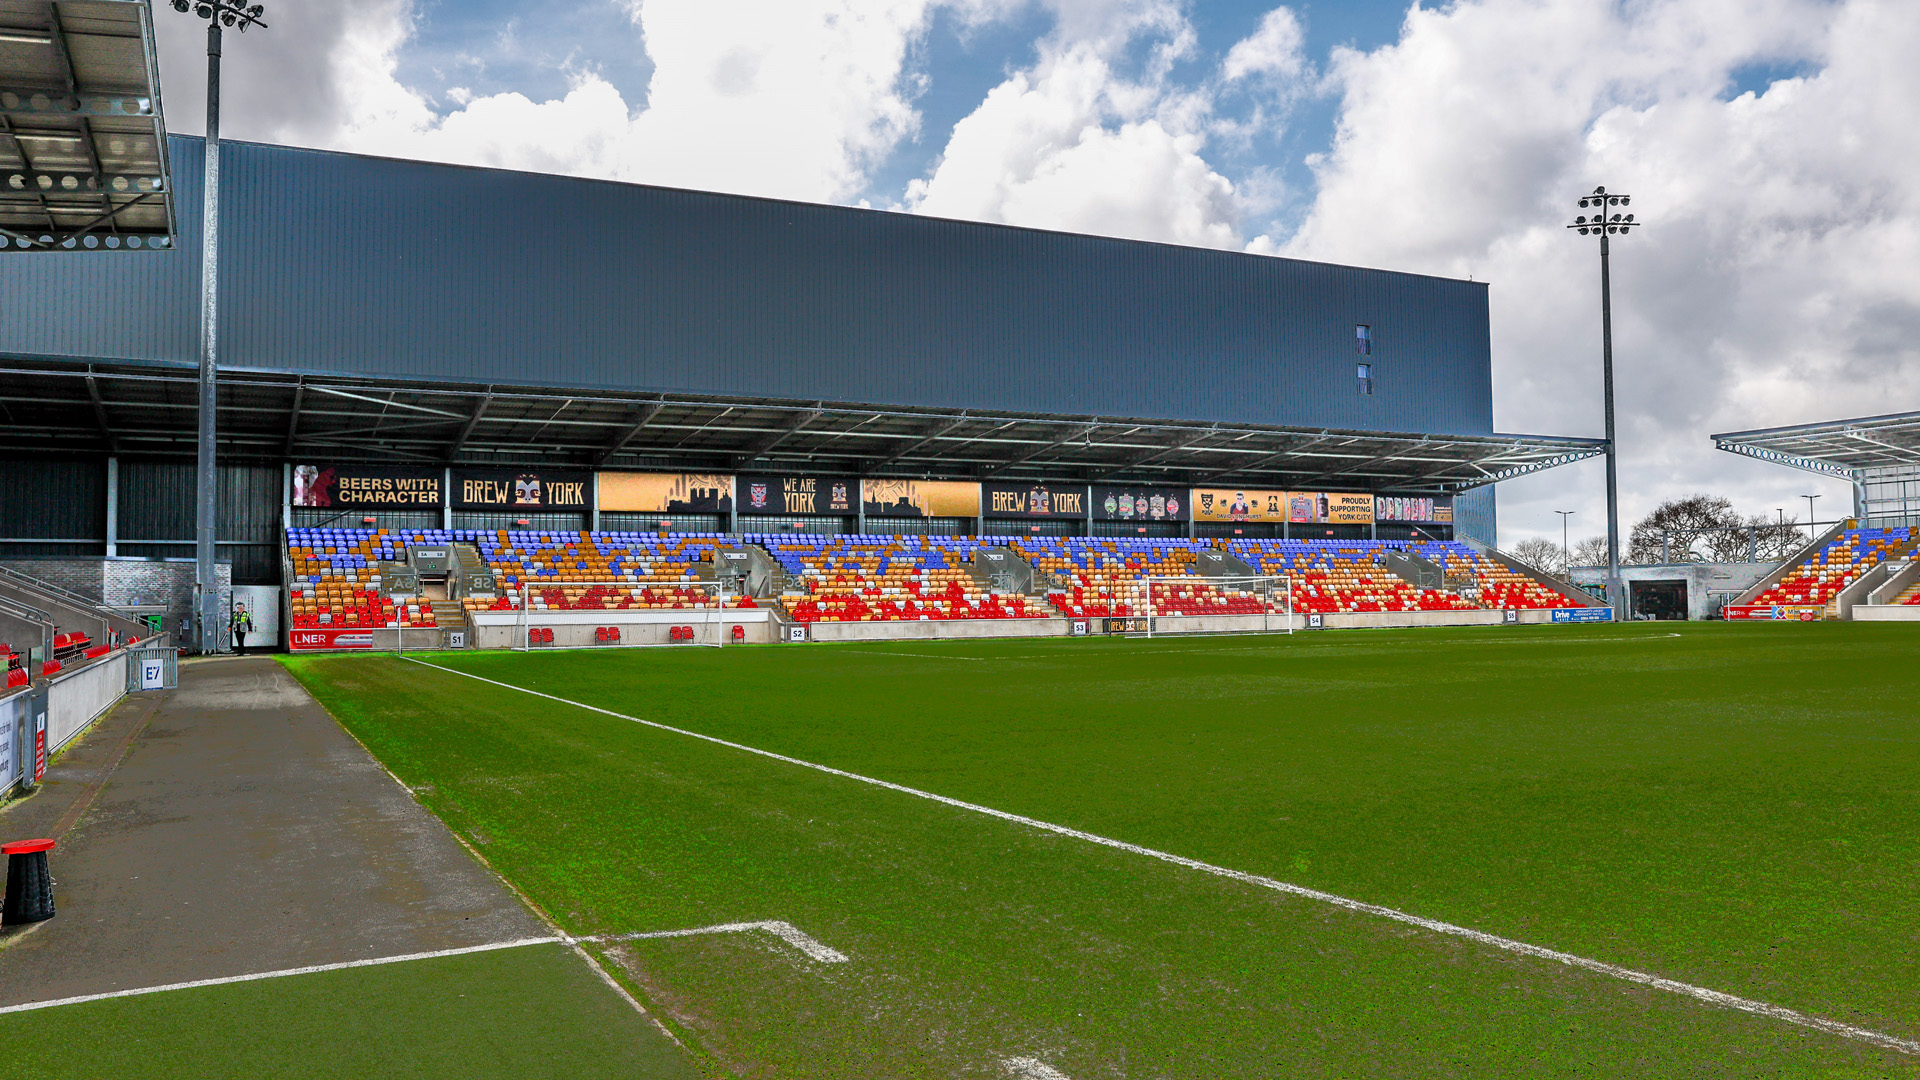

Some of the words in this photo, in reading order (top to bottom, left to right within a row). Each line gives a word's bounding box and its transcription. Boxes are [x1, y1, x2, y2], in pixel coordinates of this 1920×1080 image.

[339, 477, 392, 490] BEERS
[395, 478, 438, 491] WITH
[783, 478, 797, 492] WE
[799, 478, 816, 492] ARE
[339, 490, 439, 503] CHARACTER
[463, 480, 510, 504] BREW
[545, 482, 585, 505] YORK
[783, 492, 816, 513] YORK
[992, 491, 1026, 512] BREW
[1052, 493, 1082, 513] YORK
[1341, 497, 1371, 505] PROUDLY
[1555, 609, 1570, 619] Drive
[792, 630, 802, 638] S2
[1076, 624, 1084, 632] S3
[295, 633, 326, 644] LNER
[452, 635, 461, 645] S1
[145, 666, 160, 681] E7
